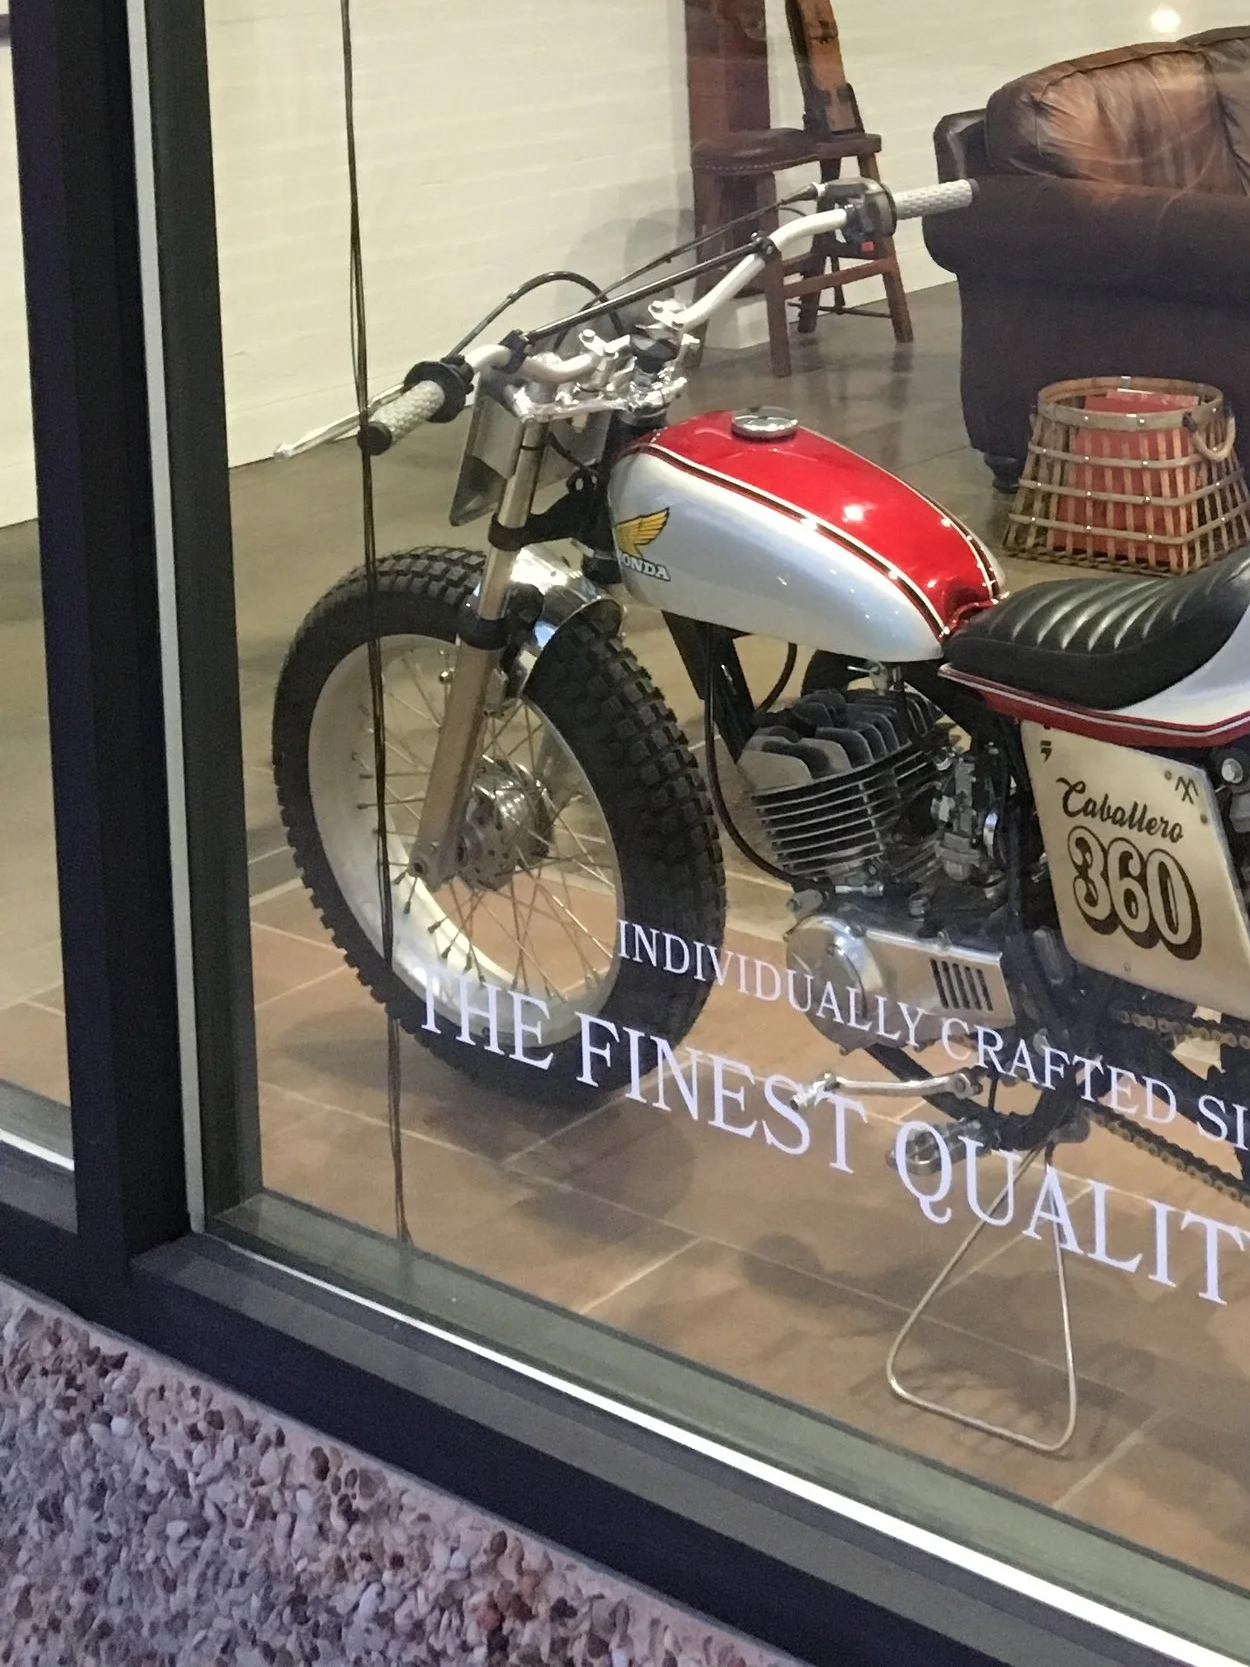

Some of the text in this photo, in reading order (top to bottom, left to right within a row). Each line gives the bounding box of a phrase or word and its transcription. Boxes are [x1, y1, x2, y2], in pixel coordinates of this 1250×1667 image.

[1056, 777, 1184, 843] Caballero
[1067, 825, 1202, 961] 360
[411, 957, 553, 1071] THE
[575, 1011, 867, 1174] FINEST
[617, 920, 928, 1048] INDIVIDUALLY
[941, 1017, 1177, 1124] CRAFTED
